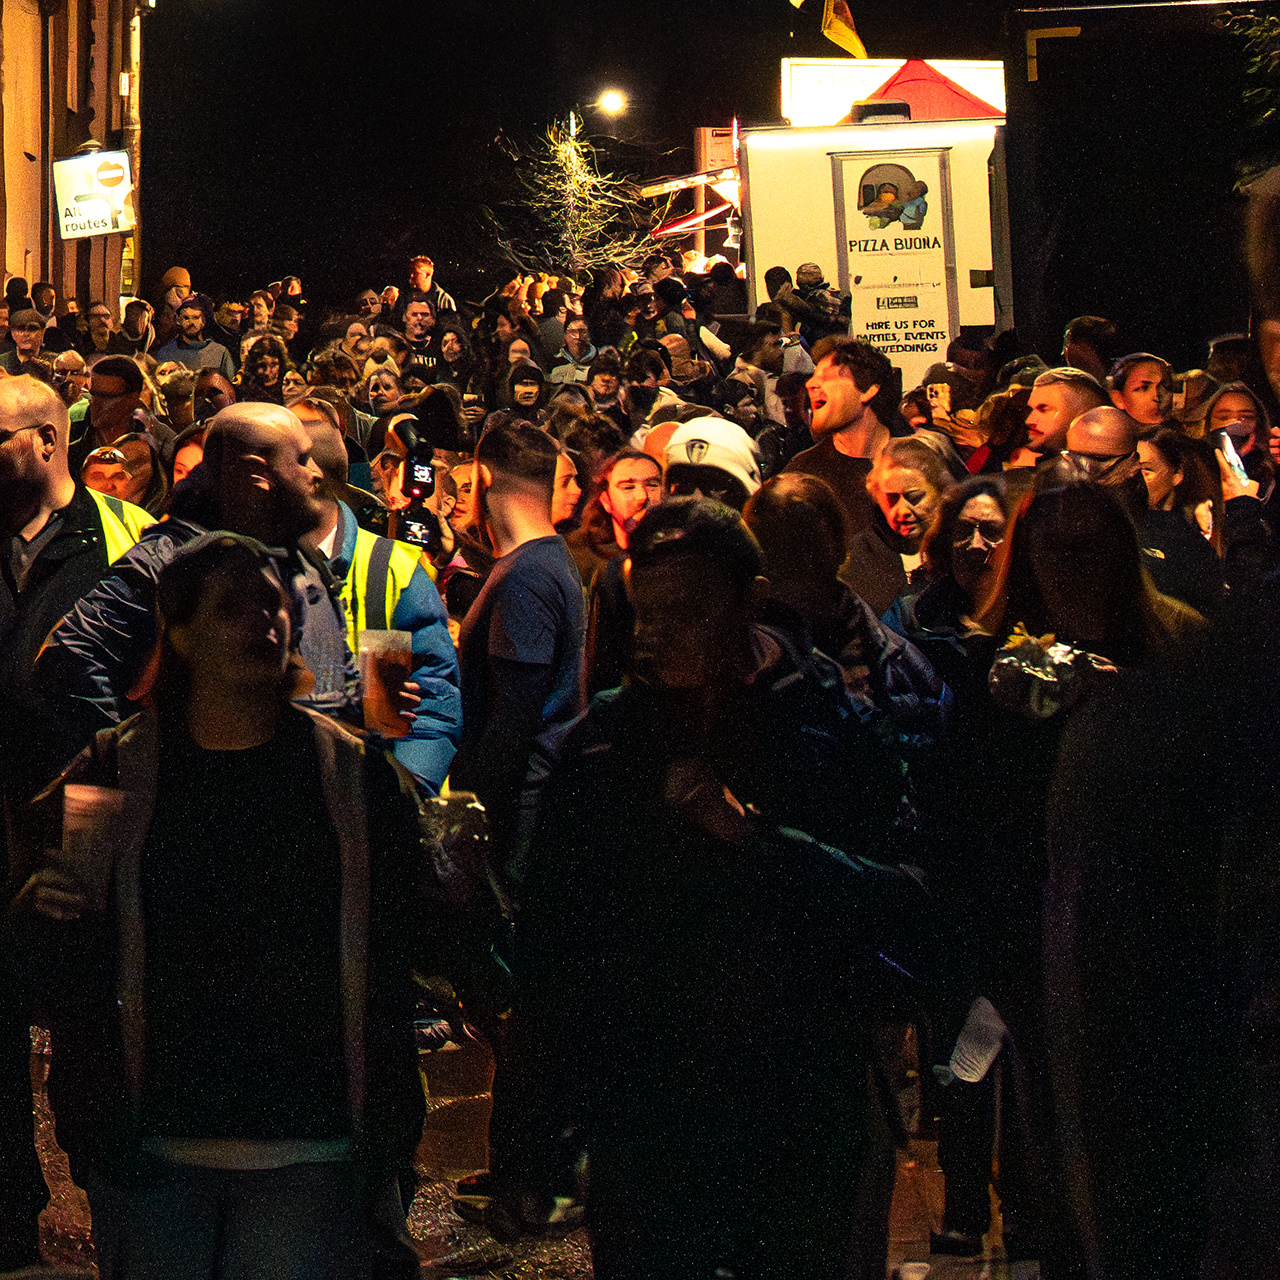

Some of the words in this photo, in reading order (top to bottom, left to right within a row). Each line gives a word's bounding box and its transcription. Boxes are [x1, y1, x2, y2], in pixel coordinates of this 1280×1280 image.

[65, 218, 108, 232] routes
[849, 239, 890, 252] PIZZA
[894, 236, 941, 251] BUONA
[866, 321, 891, 330] HIRE
[894, 320, 909, 330] US
[913, 319, 936, 329] FOR
[905, 331, 946, 341] EVENTS
